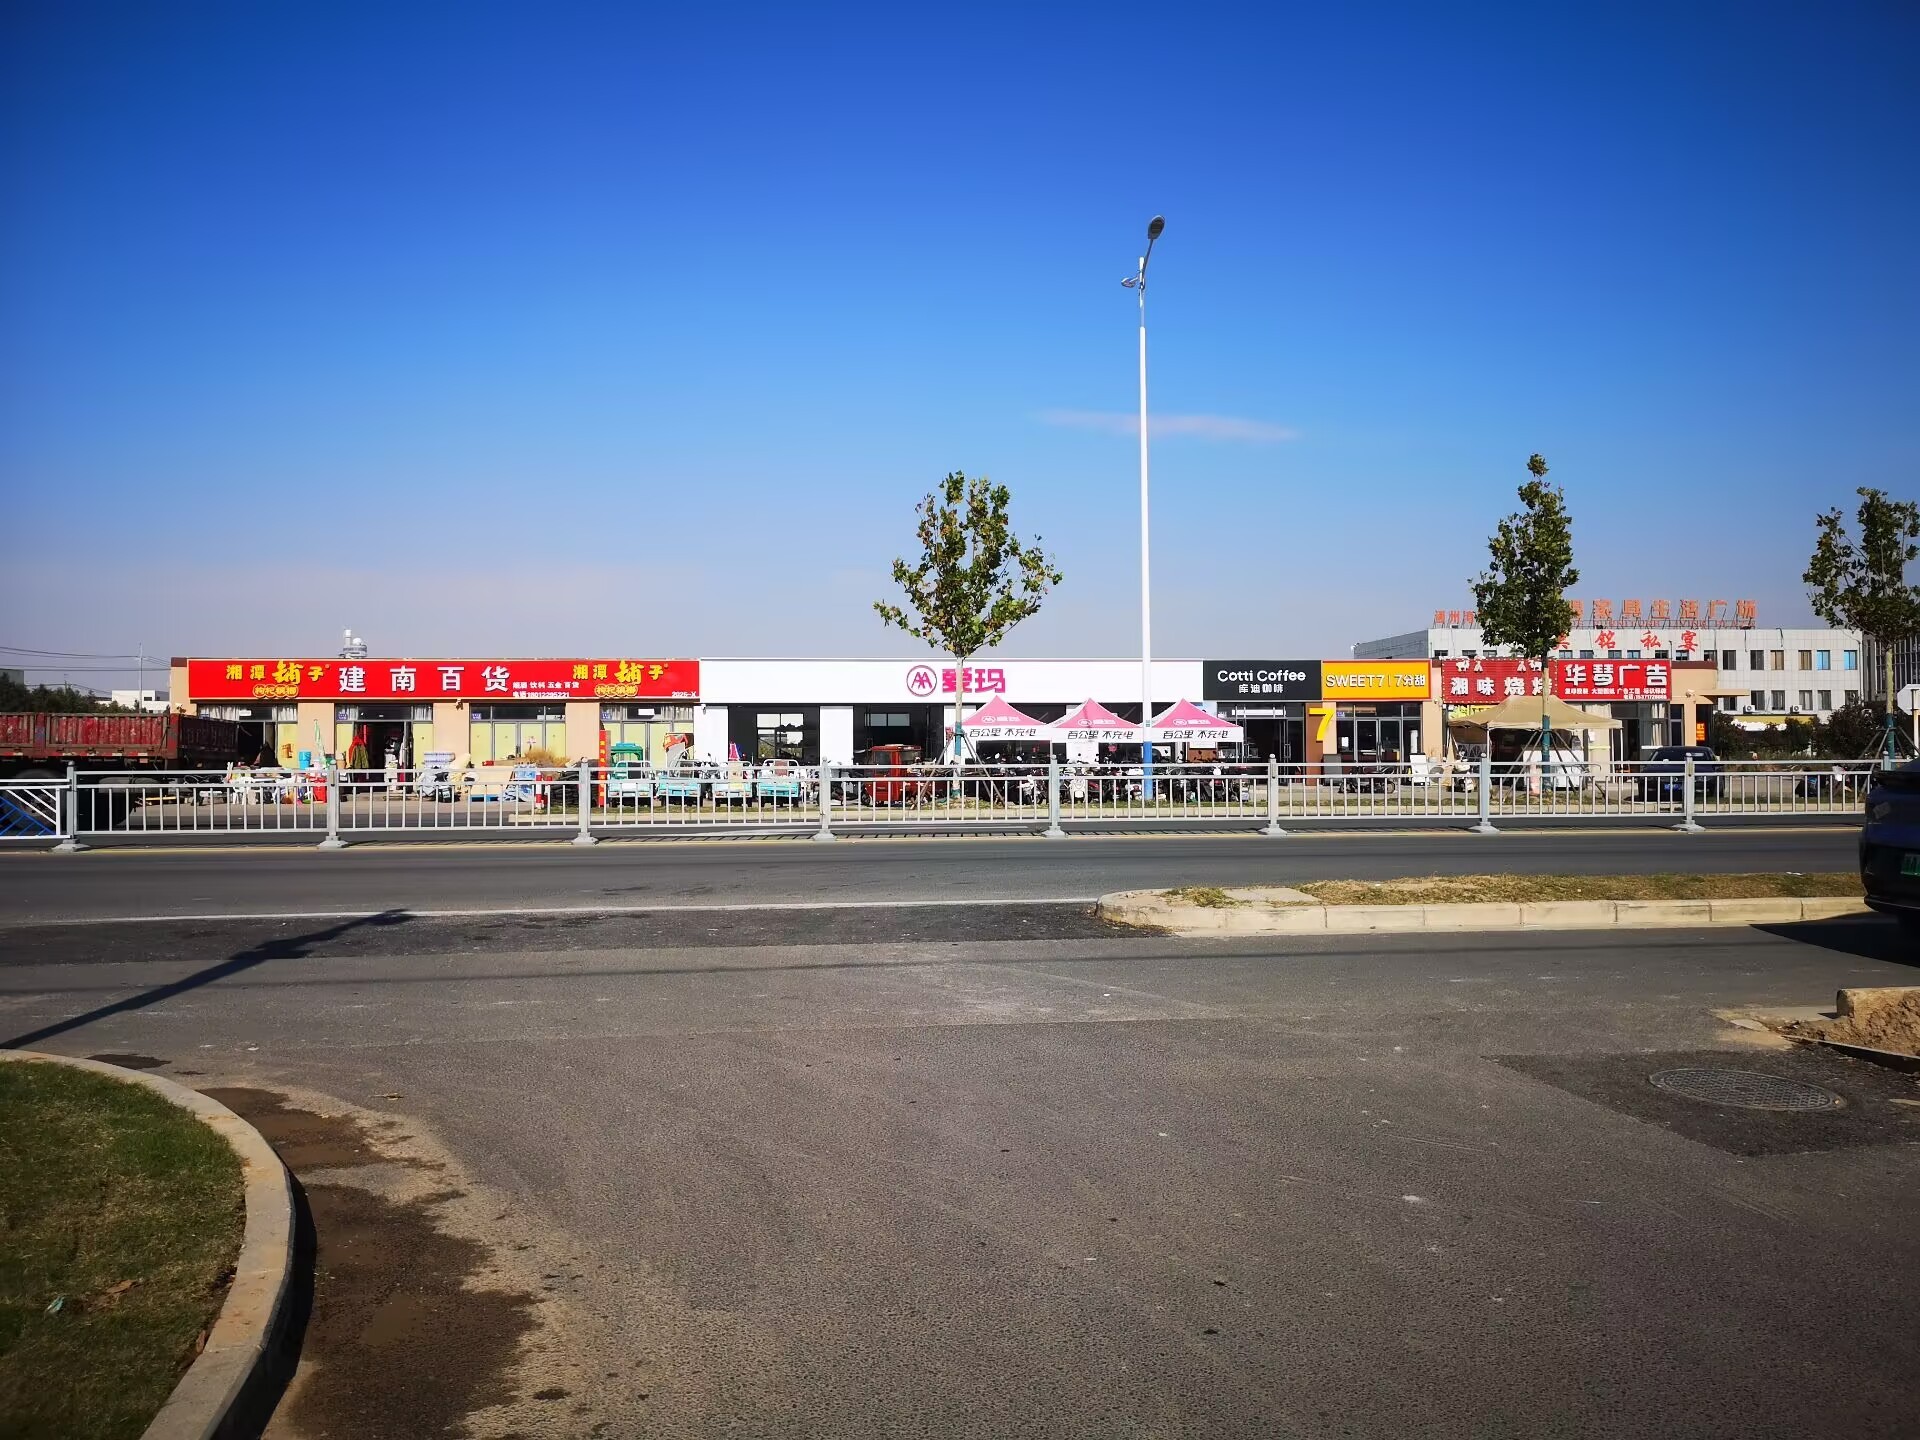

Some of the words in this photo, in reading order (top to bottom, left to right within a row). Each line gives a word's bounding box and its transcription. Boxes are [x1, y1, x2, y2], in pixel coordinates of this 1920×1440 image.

[226, 660, 324, 685] 湘潭铺子
[338, 665, 511, 692] 建南百货
[572, 660, 664, 685] 湘潭铺子
[1217, 669, 1253, 681] Cotti
[1257, 669, 1306, 681] Coffee
[942, 667, 1005, 693] 爱玛
[1326, 674, 1384, 687] SWEET7
[1395, 674, 1425, 687] 7分甜
[1239, 683, 1283, 694] 库迪咖啡
[1308, 707, 1335, 742] 7
[969, 728, 1002, 738] 百公里
[1067, 730, 1099, 740] 百公里
[1163, 730, 1194, 740] 百公里
